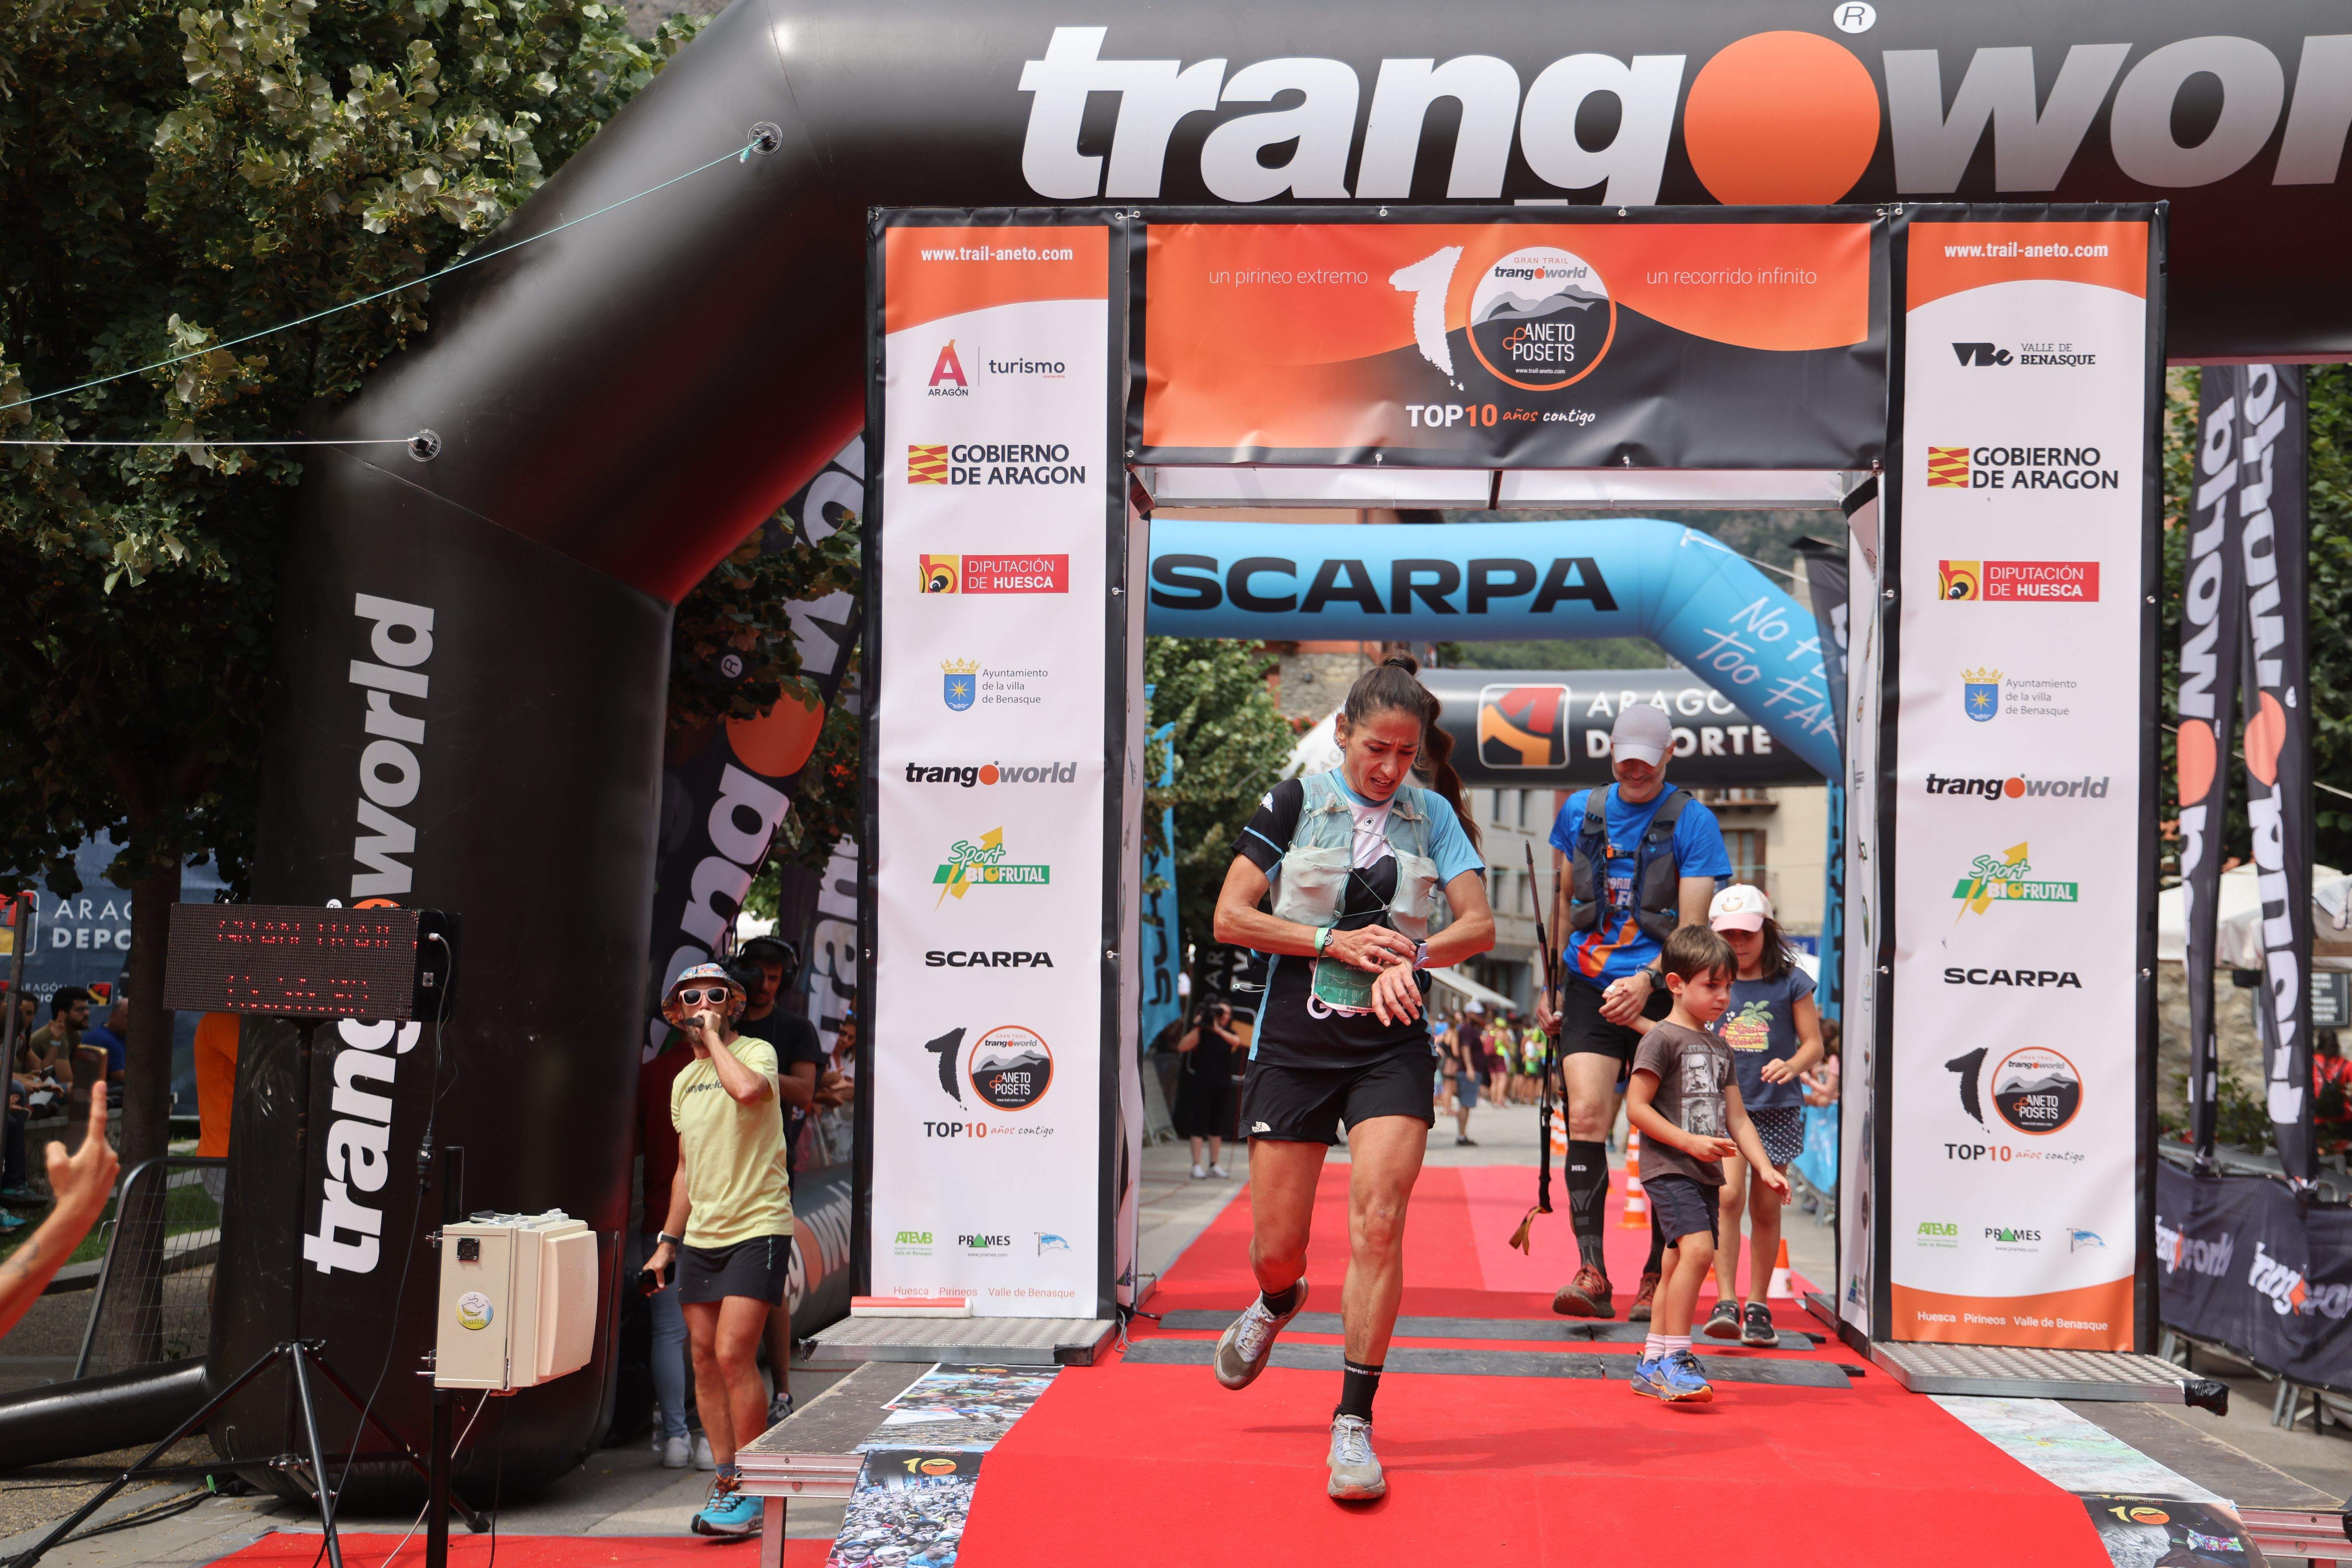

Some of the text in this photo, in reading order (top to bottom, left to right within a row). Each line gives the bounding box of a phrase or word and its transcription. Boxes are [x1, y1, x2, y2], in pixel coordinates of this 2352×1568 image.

[921, 246, 1073, 261] www.trail-aneto.com
[1944, 242, 2108, 257] www.trail-aneto.com
[1209, 268, 1368, 288] un pirineo extremo
[1647, 267, 1817, 284] un recorrido infinito
[1525, 323, 1575, 341] ANETO
[1513, 343, 1575, 362] POSETS
[2021, 343, 2072, 352] VALLE DE
[989, 358, 1065, 374] turismo
[2021, 355, 2096, 366] BENASQUE
[928, 387, 968, 396] ARAGÓN
[1502, 409, 1538, 421] años
[1543, 410, 1595, 426] contigo
[951, 444, 1069, 462] GOBIERNO
[1973, 447, 2101, 466] GOBIERNO
[951, 466, 1086, 485] DE ARAGON
[1973, 470, 2118, 489] DE ARAGON
[969, 558, 1054, 573] DIPUTACIÓN
[1990, 565, 2084, 580] DIPUTACIÓN
[969, 577, 1054, 589] DE HUESCA
[1150, 554, 1619, 614] SCARPA
[1990, 584, 2083, 597] DE HUESCA
[1729, 596, 1789, 642] NO
[1696, 628, 1761, 685] TOO
[982, 669, 1048, 679] Ayuntamiento
[982, 682, 1025, 690] de la villa
[2005, 679, 2077, 689] Ayuntamiento
[982, 695, 1041, 705] de Benasque
[2005, 692, 2052, 702] de la villa
[2005, 706, 2069, 716] de Benasque
[1586, 725, 1773, 759] DORTE
[948, 840, 1006, 870] Sport
[1969, 854, 2030, 886] Sport
[52, 928, 131, 950] DEPO
[925, 951, 1054, 967] SCARPA
[1944, 967, 2082, 988] SCARPA
[1002, 1072, 1031, 1084] ANETO
[995, 1083, 1031, 1095] POSETS
[2026, 1094, 2058, 1108] ANETO
[2019, 1106, 2058, 1119] POSETS
[991, 1125, 1015, 1135] años
[1018, 1124, 1054, 1138] contigo
[2015, 1150, 2042, 1160] años
[2045, 1151, 2084, 1163] contigo
[895, 1231, 933, 1244] ATEVB
[894, 1286, 1075, 1299] Huesca Pirineos Valle de Benasque
[1917, 1311, 2108, 1332] Huesca Pirineos Valle de Benasque
